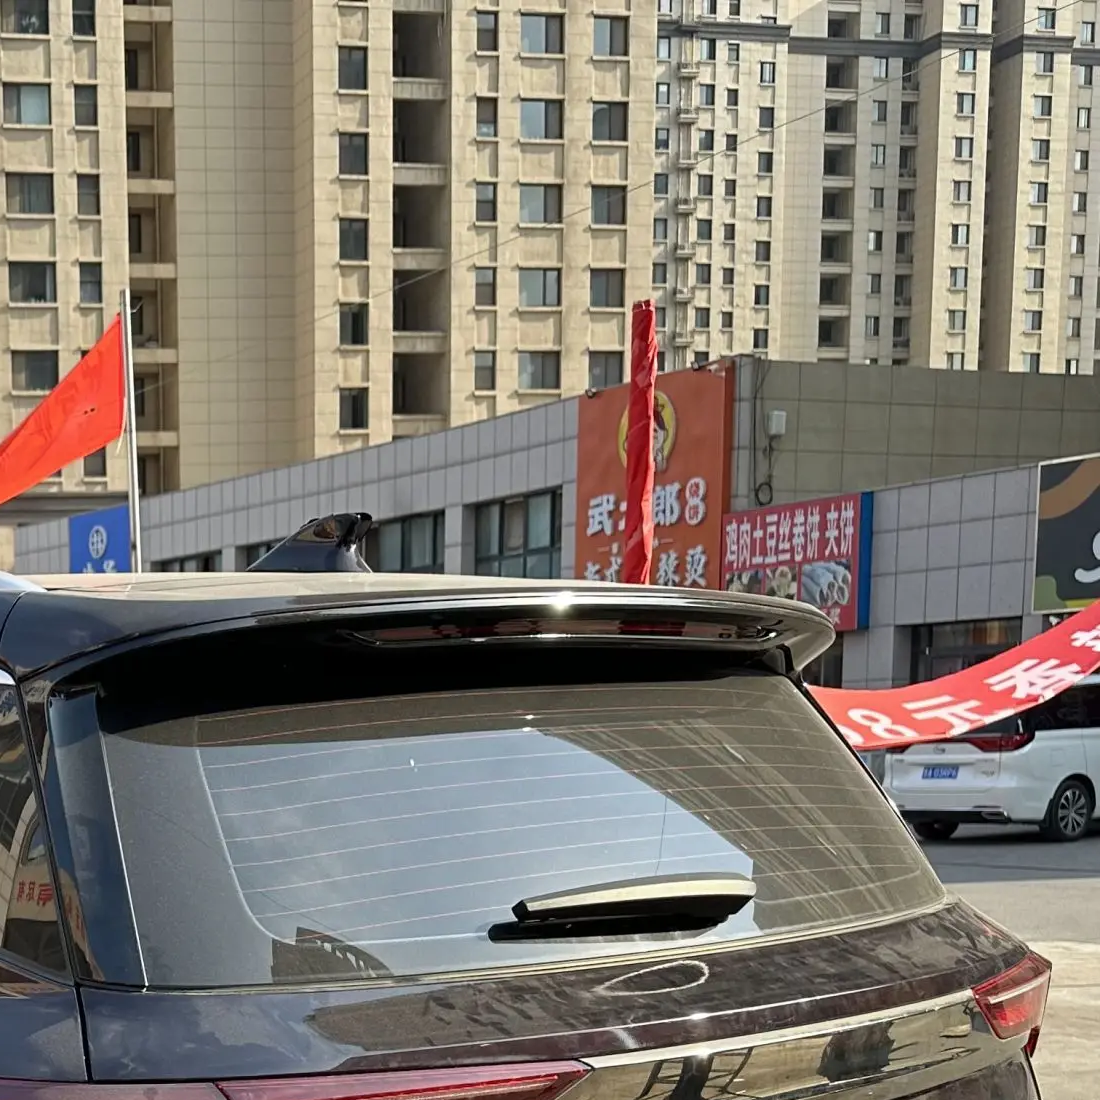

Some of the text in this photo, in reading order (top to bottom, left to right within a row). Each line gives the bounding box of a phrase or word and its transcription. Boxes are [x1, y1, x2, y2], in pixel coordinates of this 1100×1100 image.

[586, 482, 681, 536] 武郎
[725, 500, 854, 570] 鸡肉土豆丝卷饼 夹饼
[584, 545, 707, 587] 老式辣烫
